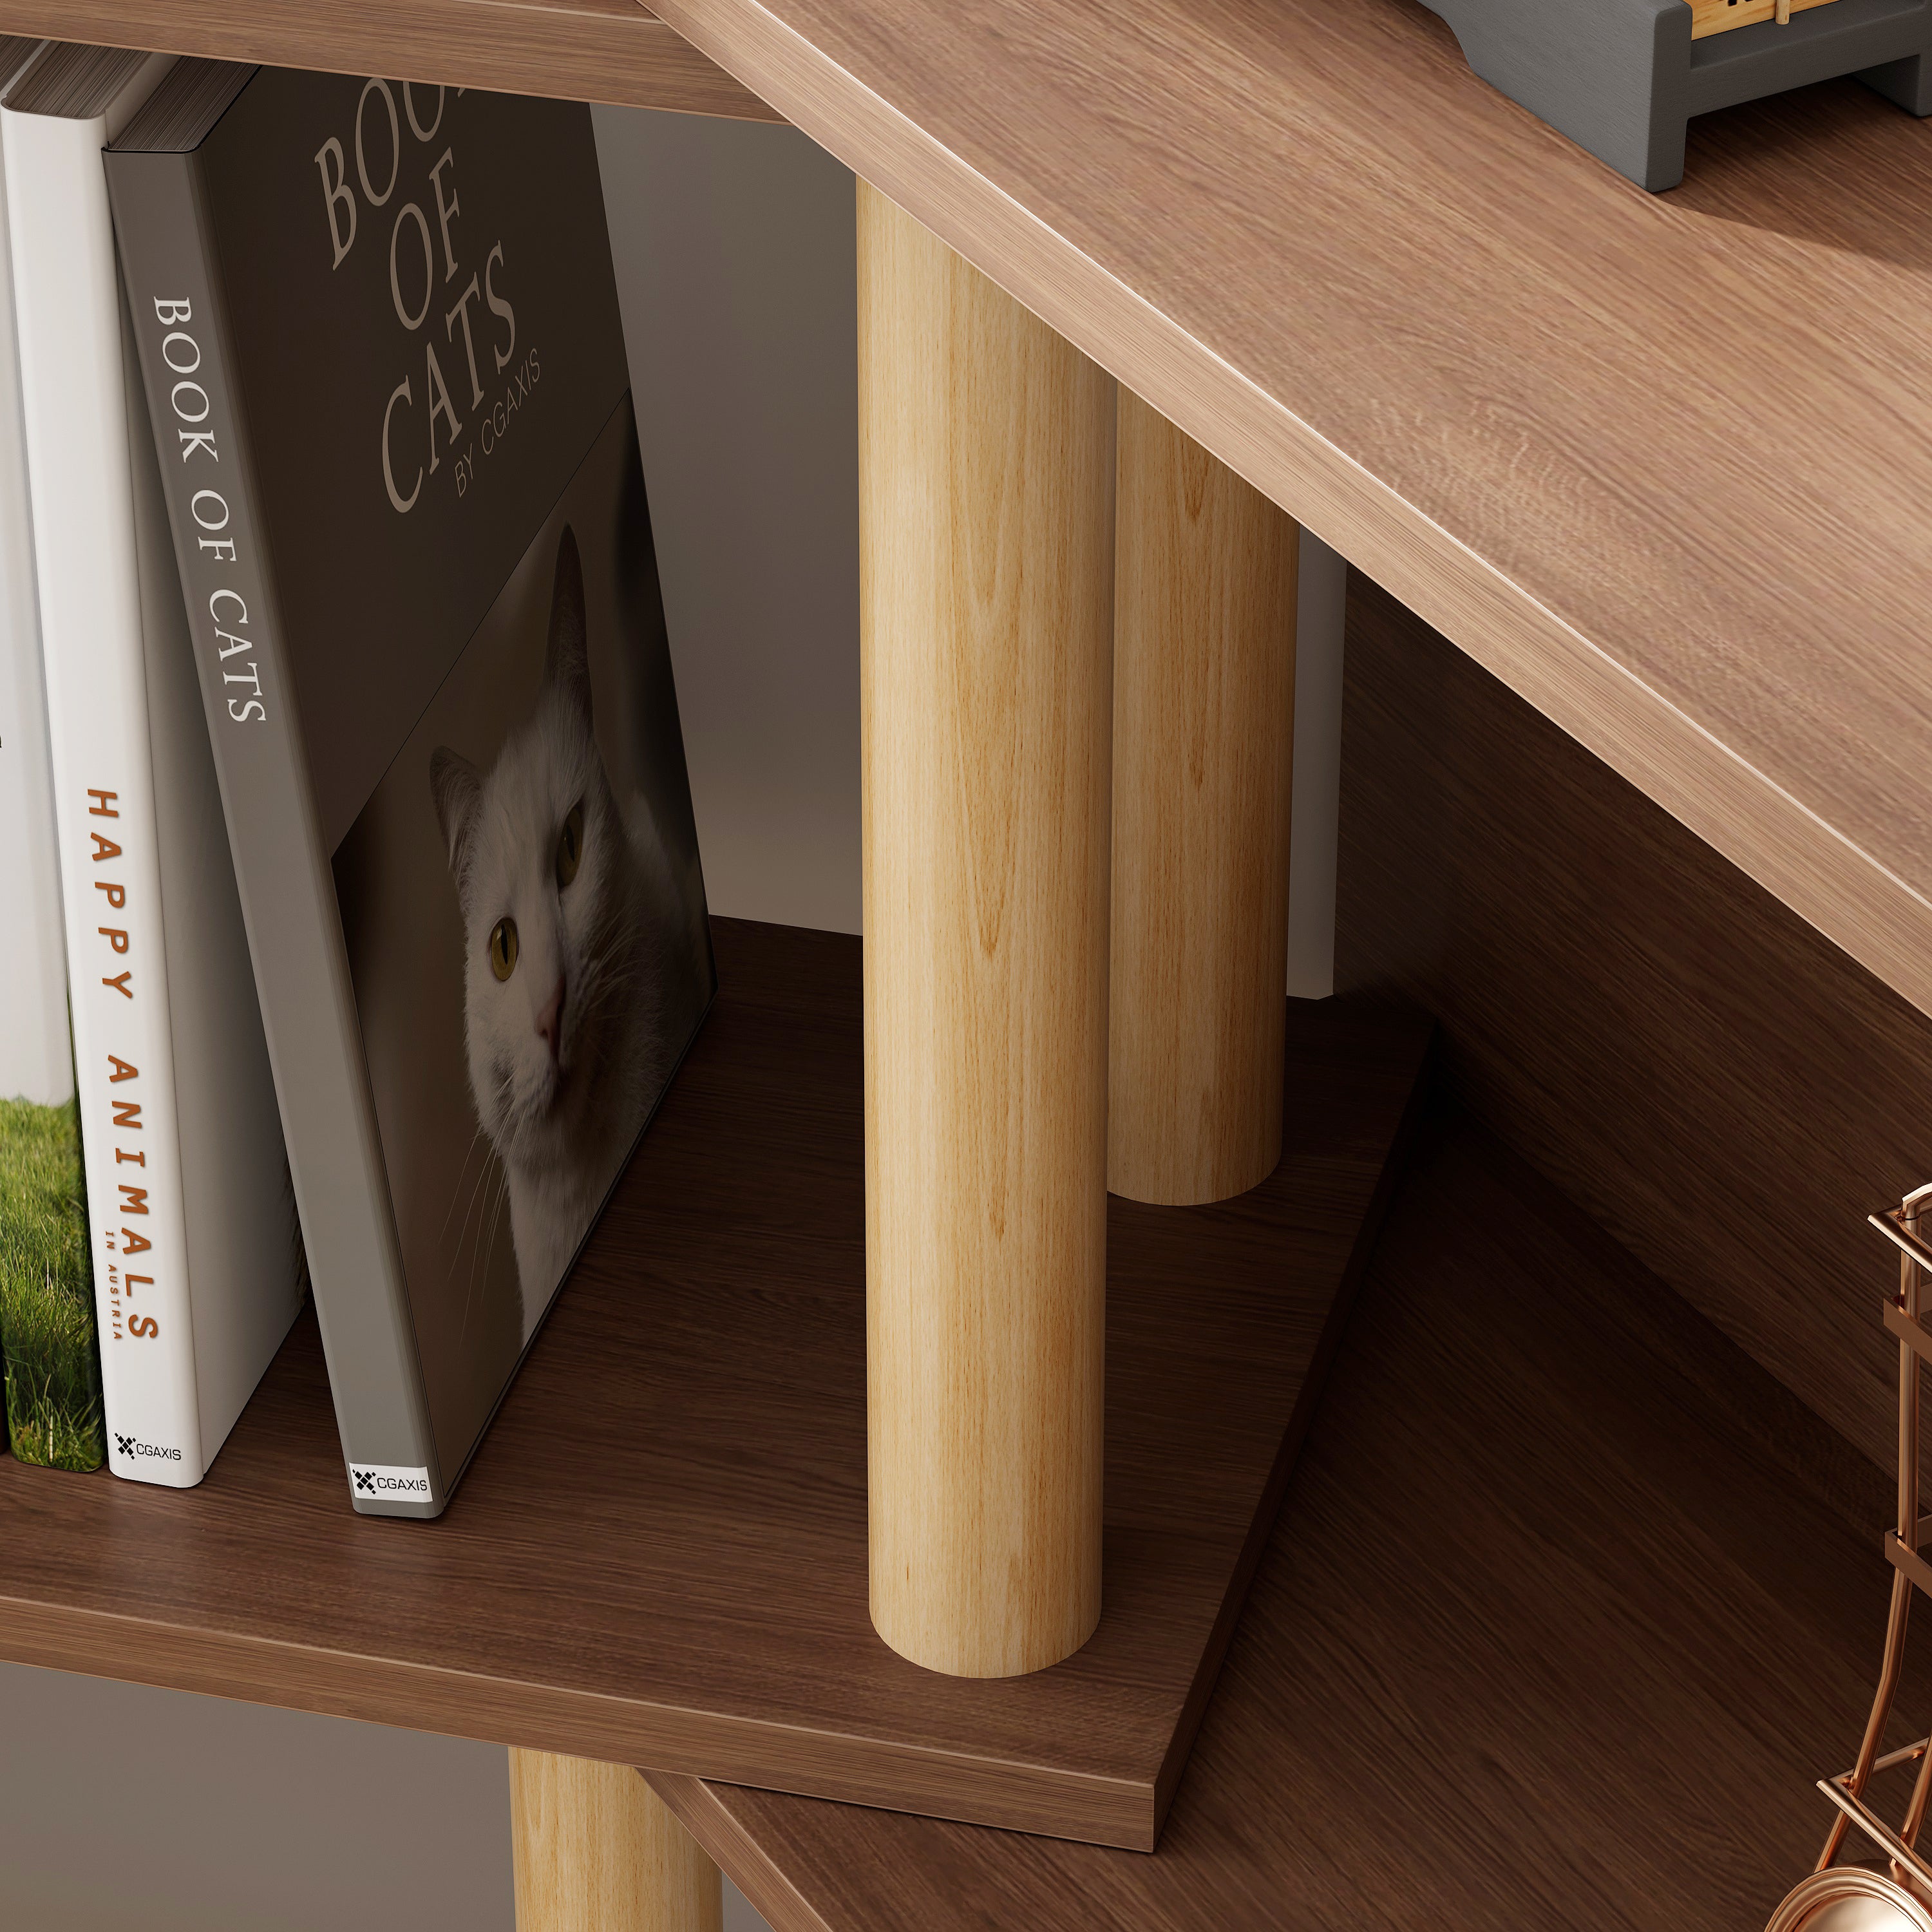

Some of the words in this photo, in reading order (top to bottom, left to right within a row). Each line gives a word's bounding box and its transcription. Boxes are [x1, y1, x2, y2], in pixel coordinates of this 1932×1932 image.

[314, 77, 466, 271] BOO
[390, 147, 460, 330] OF
[153, 296, 219, 463] BOOK
[382, 240, 515, 513] CATS
[455, 442, 473, 498] BY
[482, 348, 540, 455] CGAXIS
[191, 489, 237, 562] OF
[209, 589, 267, 722] CATS
[88, 789, 133, 999] HAPPY
[106, 1231, 115, 1249] IN
[108, 1055, 158, 1338] ANIMALS
[108, 1264, 122, 1340] AUSTRIA
[136, 1443, 182, 1461] CGAXIS
[377, 1477, 428, 1491] CGAXIS
